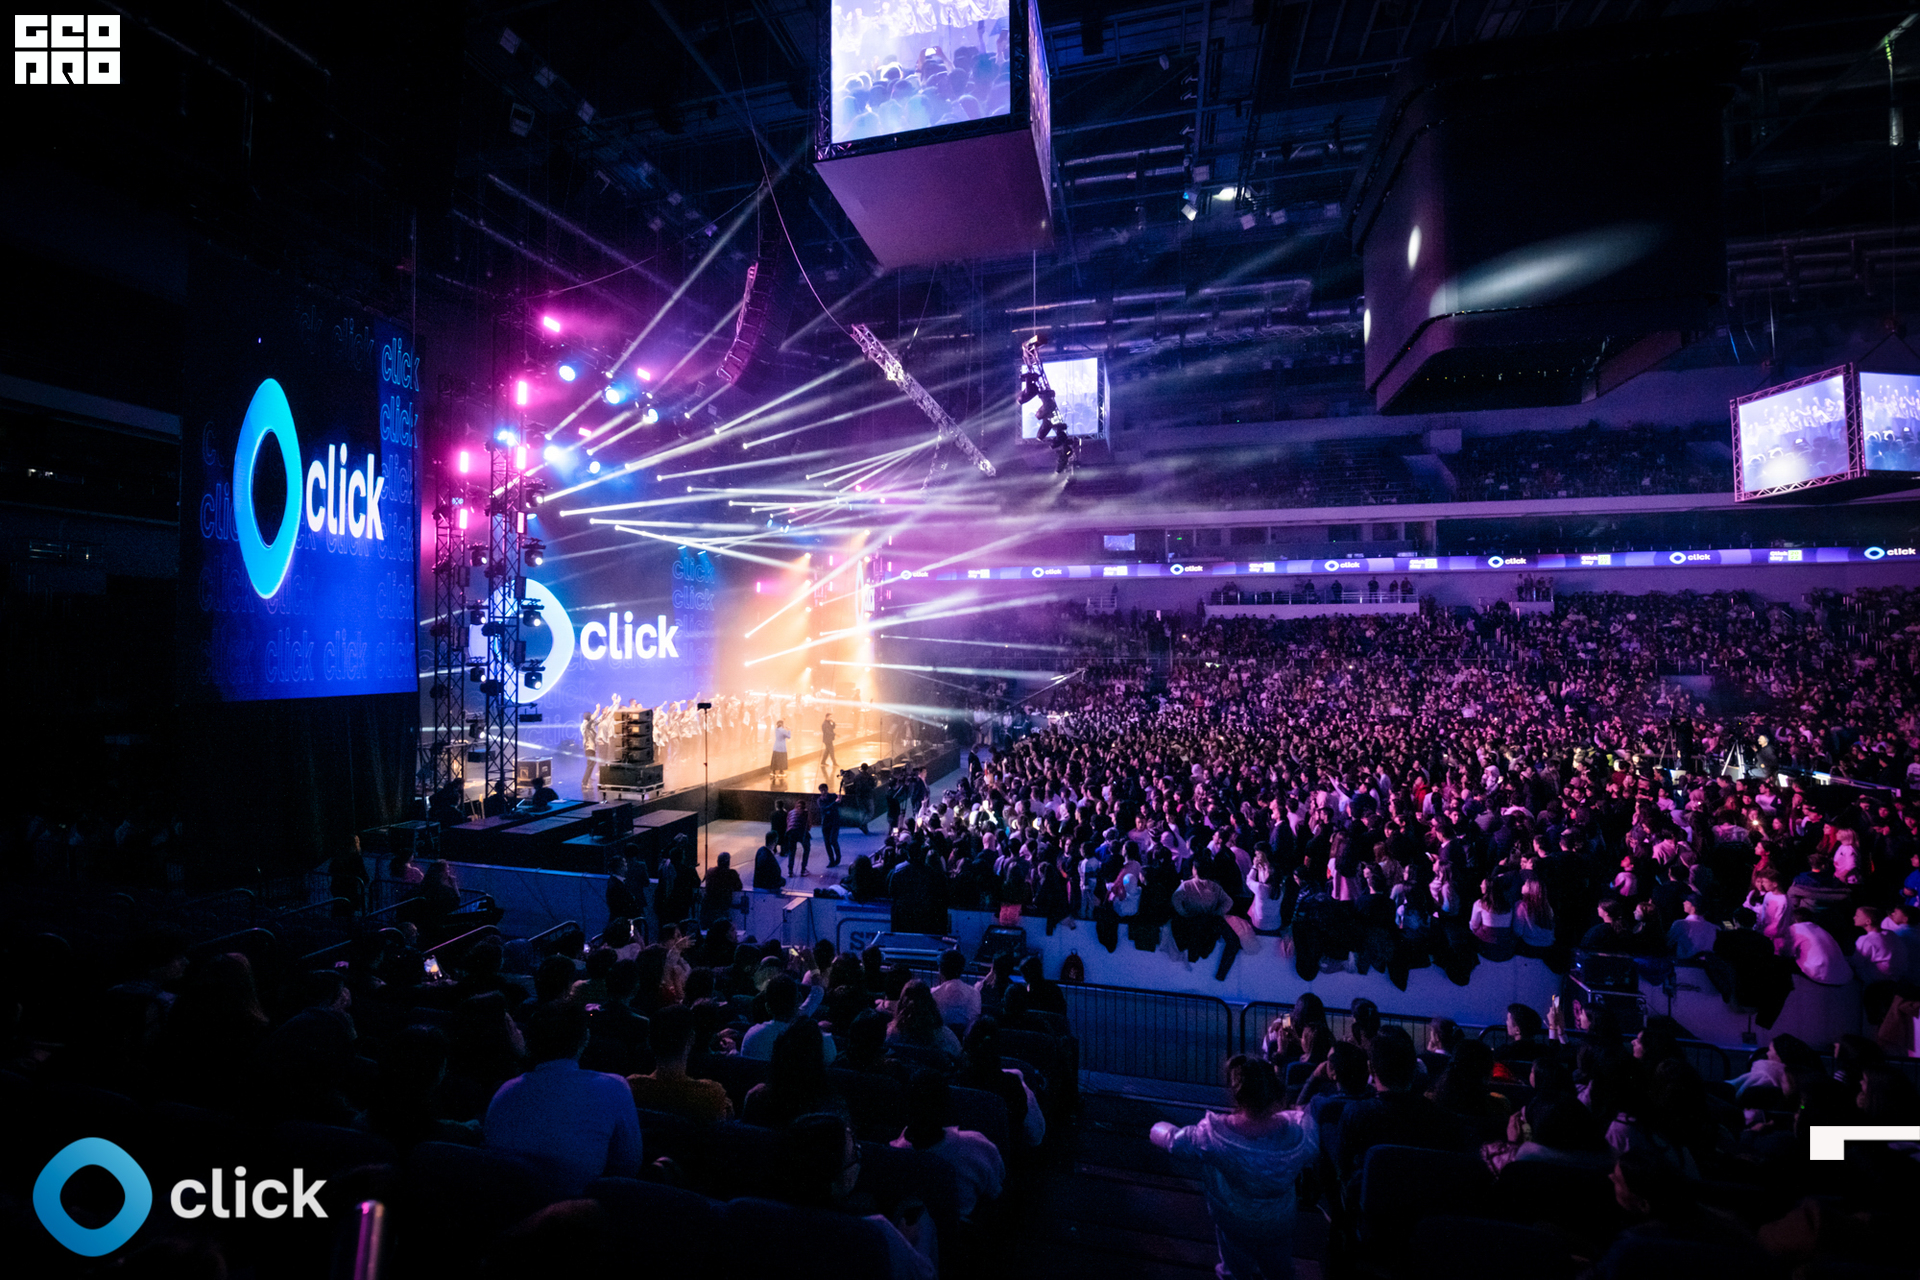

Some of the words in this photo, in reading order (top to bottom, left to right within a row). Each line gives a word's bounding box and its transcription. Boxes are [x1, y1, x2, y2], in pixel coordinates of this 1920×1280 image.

[382, 337, 420, 392] click
[380, 395, 418, 449] click
[306, 442, 385, 541] click
[672, 557, 715, 584] click
[1886, 547, 1916, 556] click
[672, 585, 715, 611] click
[265, 626, 315, 683] click
[323, 628, 368, 681] click
[580, 611, 679, 661] click
